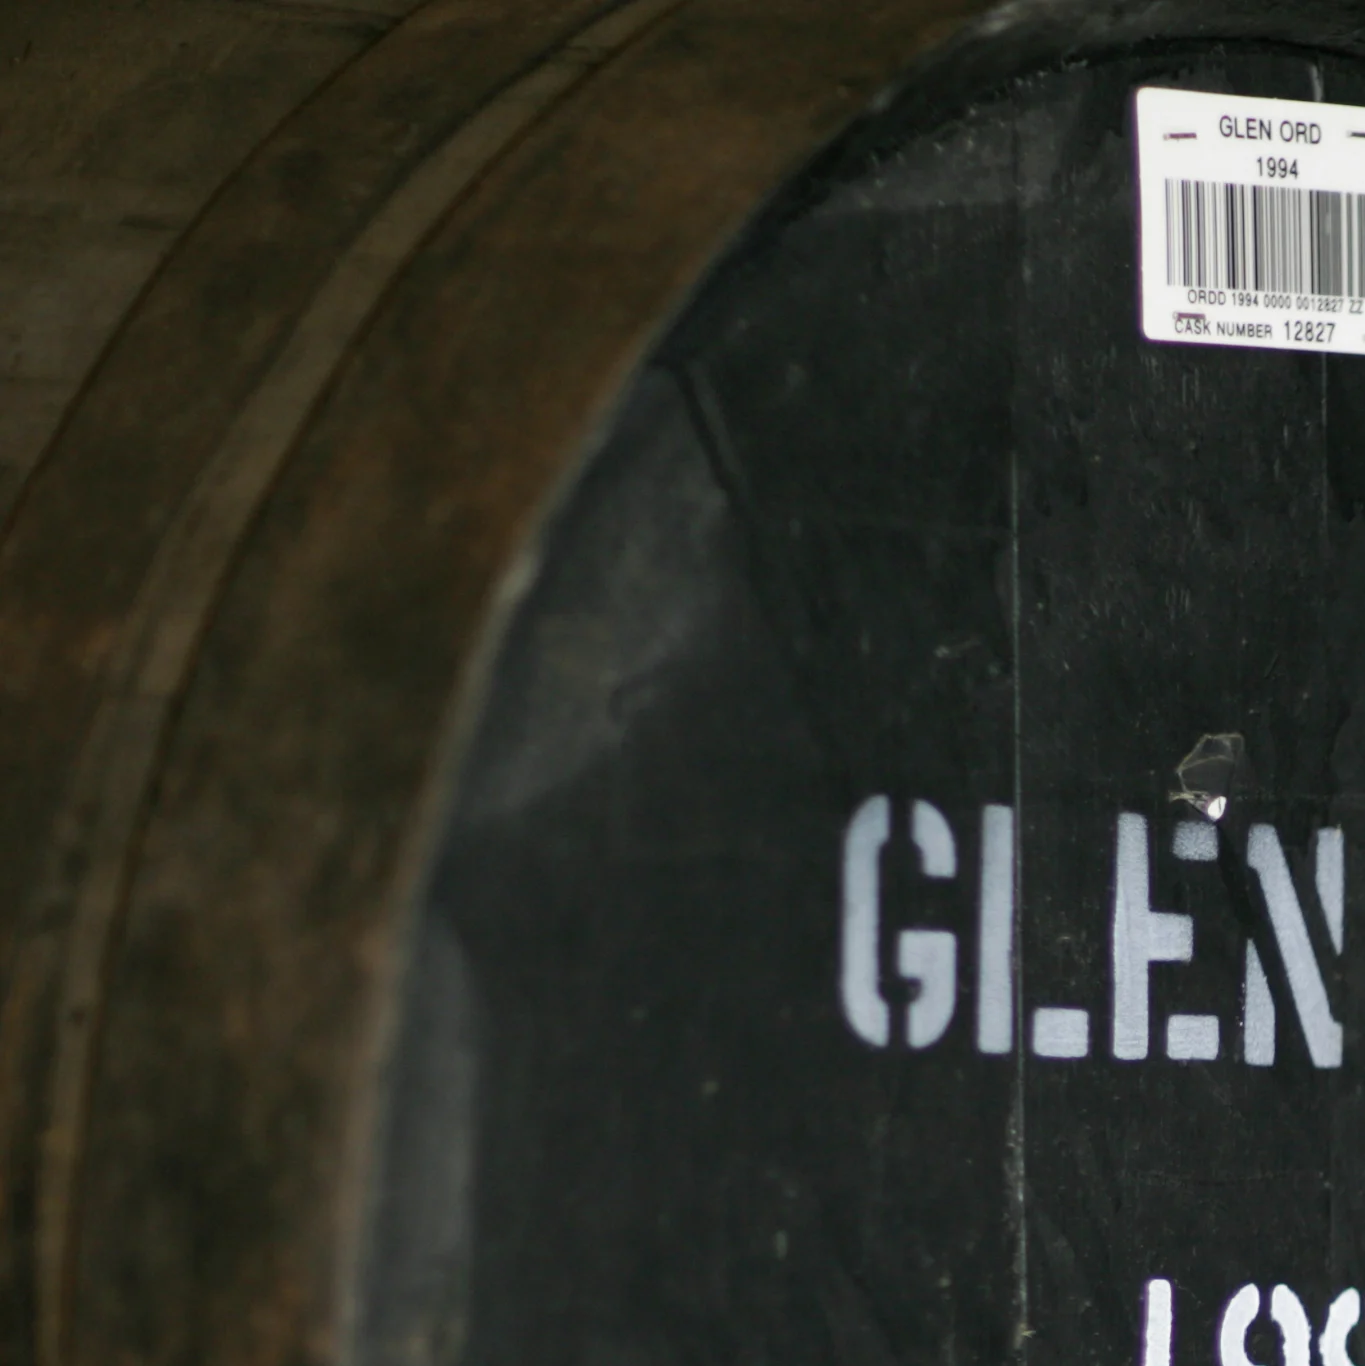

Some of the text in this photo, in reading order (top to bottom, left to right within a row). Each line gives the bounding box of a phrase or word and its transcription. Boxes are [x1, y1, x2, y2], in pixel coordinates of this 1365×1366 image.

[1219, 115, 1322, 145] GLEN ORD
[1256, 156, 1299, 179] 1994
[1187, 289, 1227, 305] ORDD
[1232, 292, 1259, 307] 1994
[1264, 294, 1291, 309] 0000
[1296, 296, 1343, 313] 0012827
[1174, 318, 1336, 343] CASK NUMBER 12827
[839, 795, 1344, 1068] GLEN
